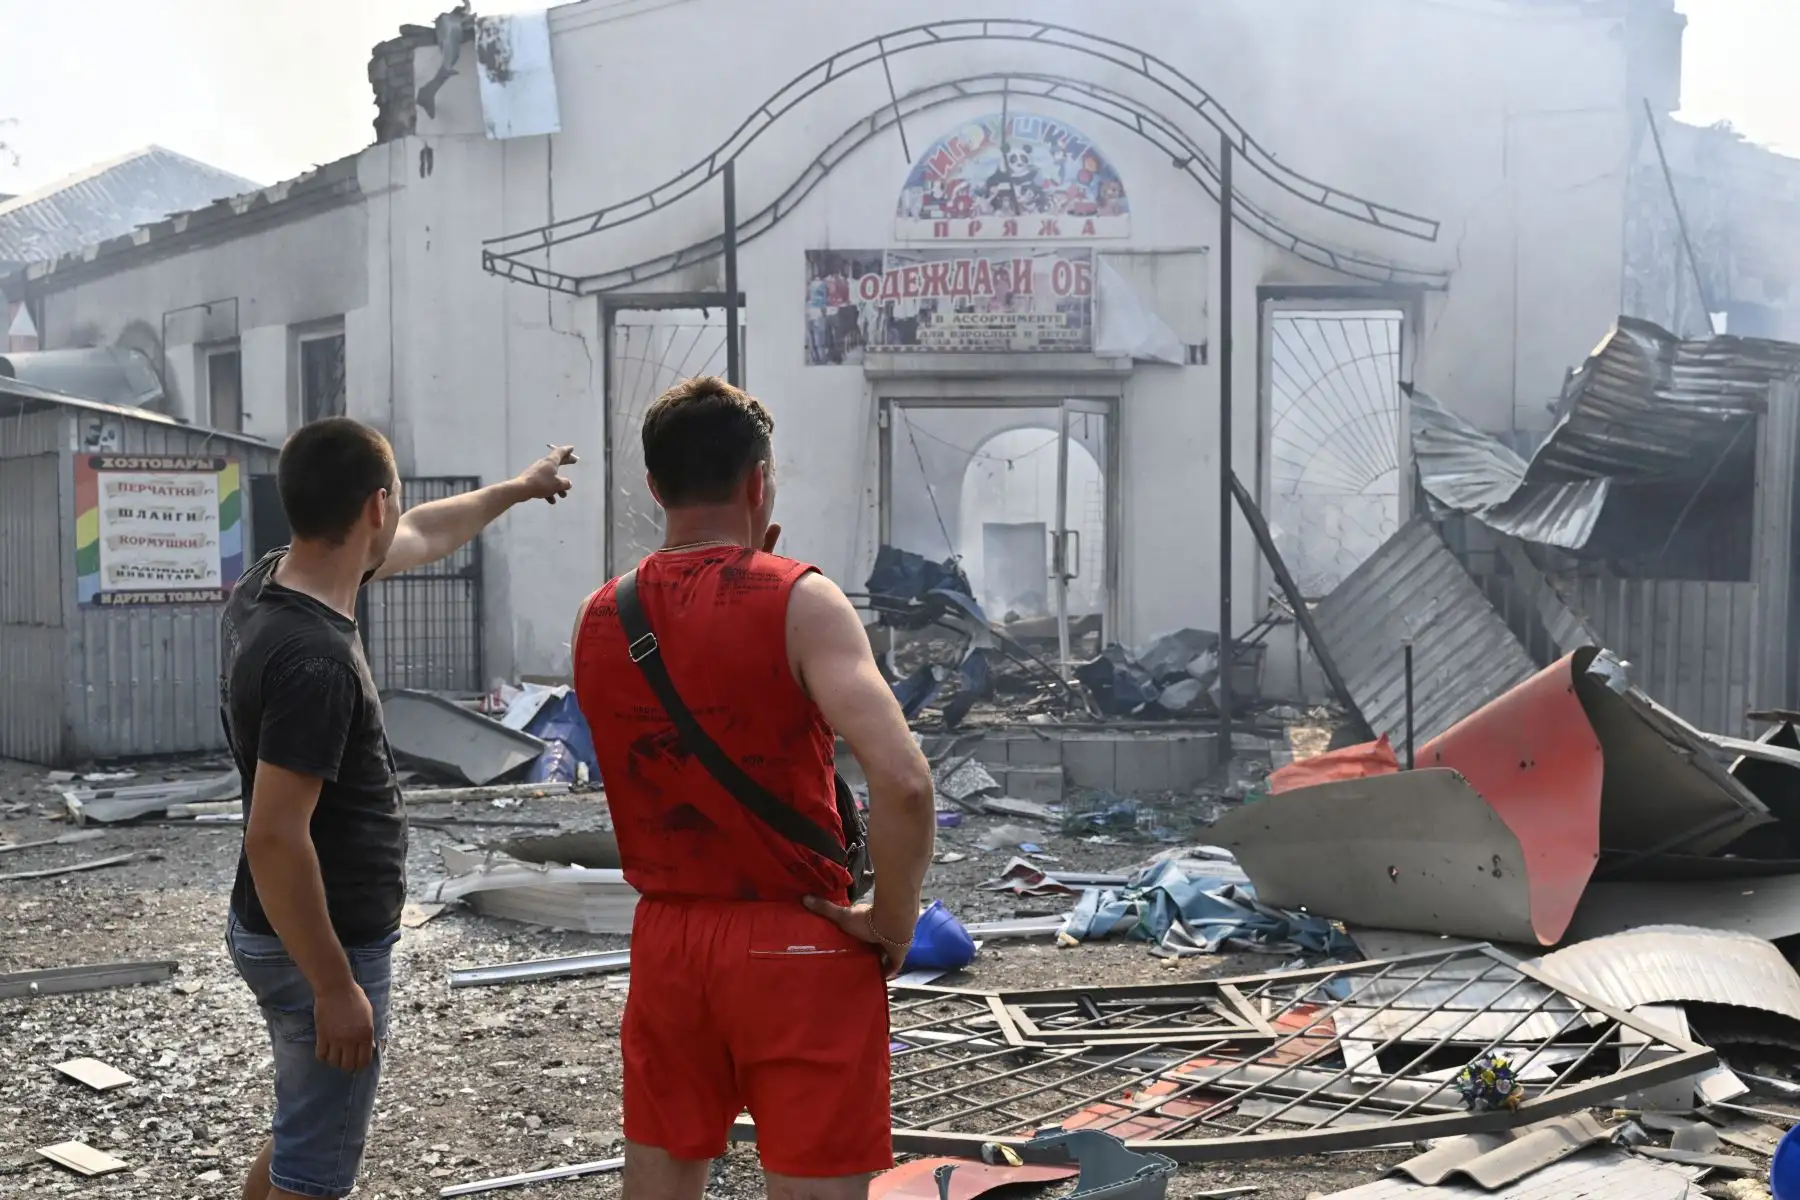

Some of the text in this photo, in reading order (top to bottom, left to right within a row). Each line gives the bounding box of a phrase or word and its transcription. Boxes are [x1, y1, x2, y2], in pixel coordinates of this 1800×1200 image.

[933, 219, 1097, 237] ПРЯЖА
[858, 257, 995, 306] ОДЕЖДА
[1011, 257, 1034, 296] И
[952, 314, 1064, 325] АССОРТИМЕНТЕ
[102, 458, 213, 469] ХОЗТОВАРЫ
[118, 482, 196, 496] ПЕРЧАТКИ
[118, 508, 197, 521] ШЛАНГИ
[119, 535, 198, 548] КОРМУШКИ
[113, 592, 165, 605] ДРУГИЕ
[167, 591, 222, 601] ТОВАРЫ
